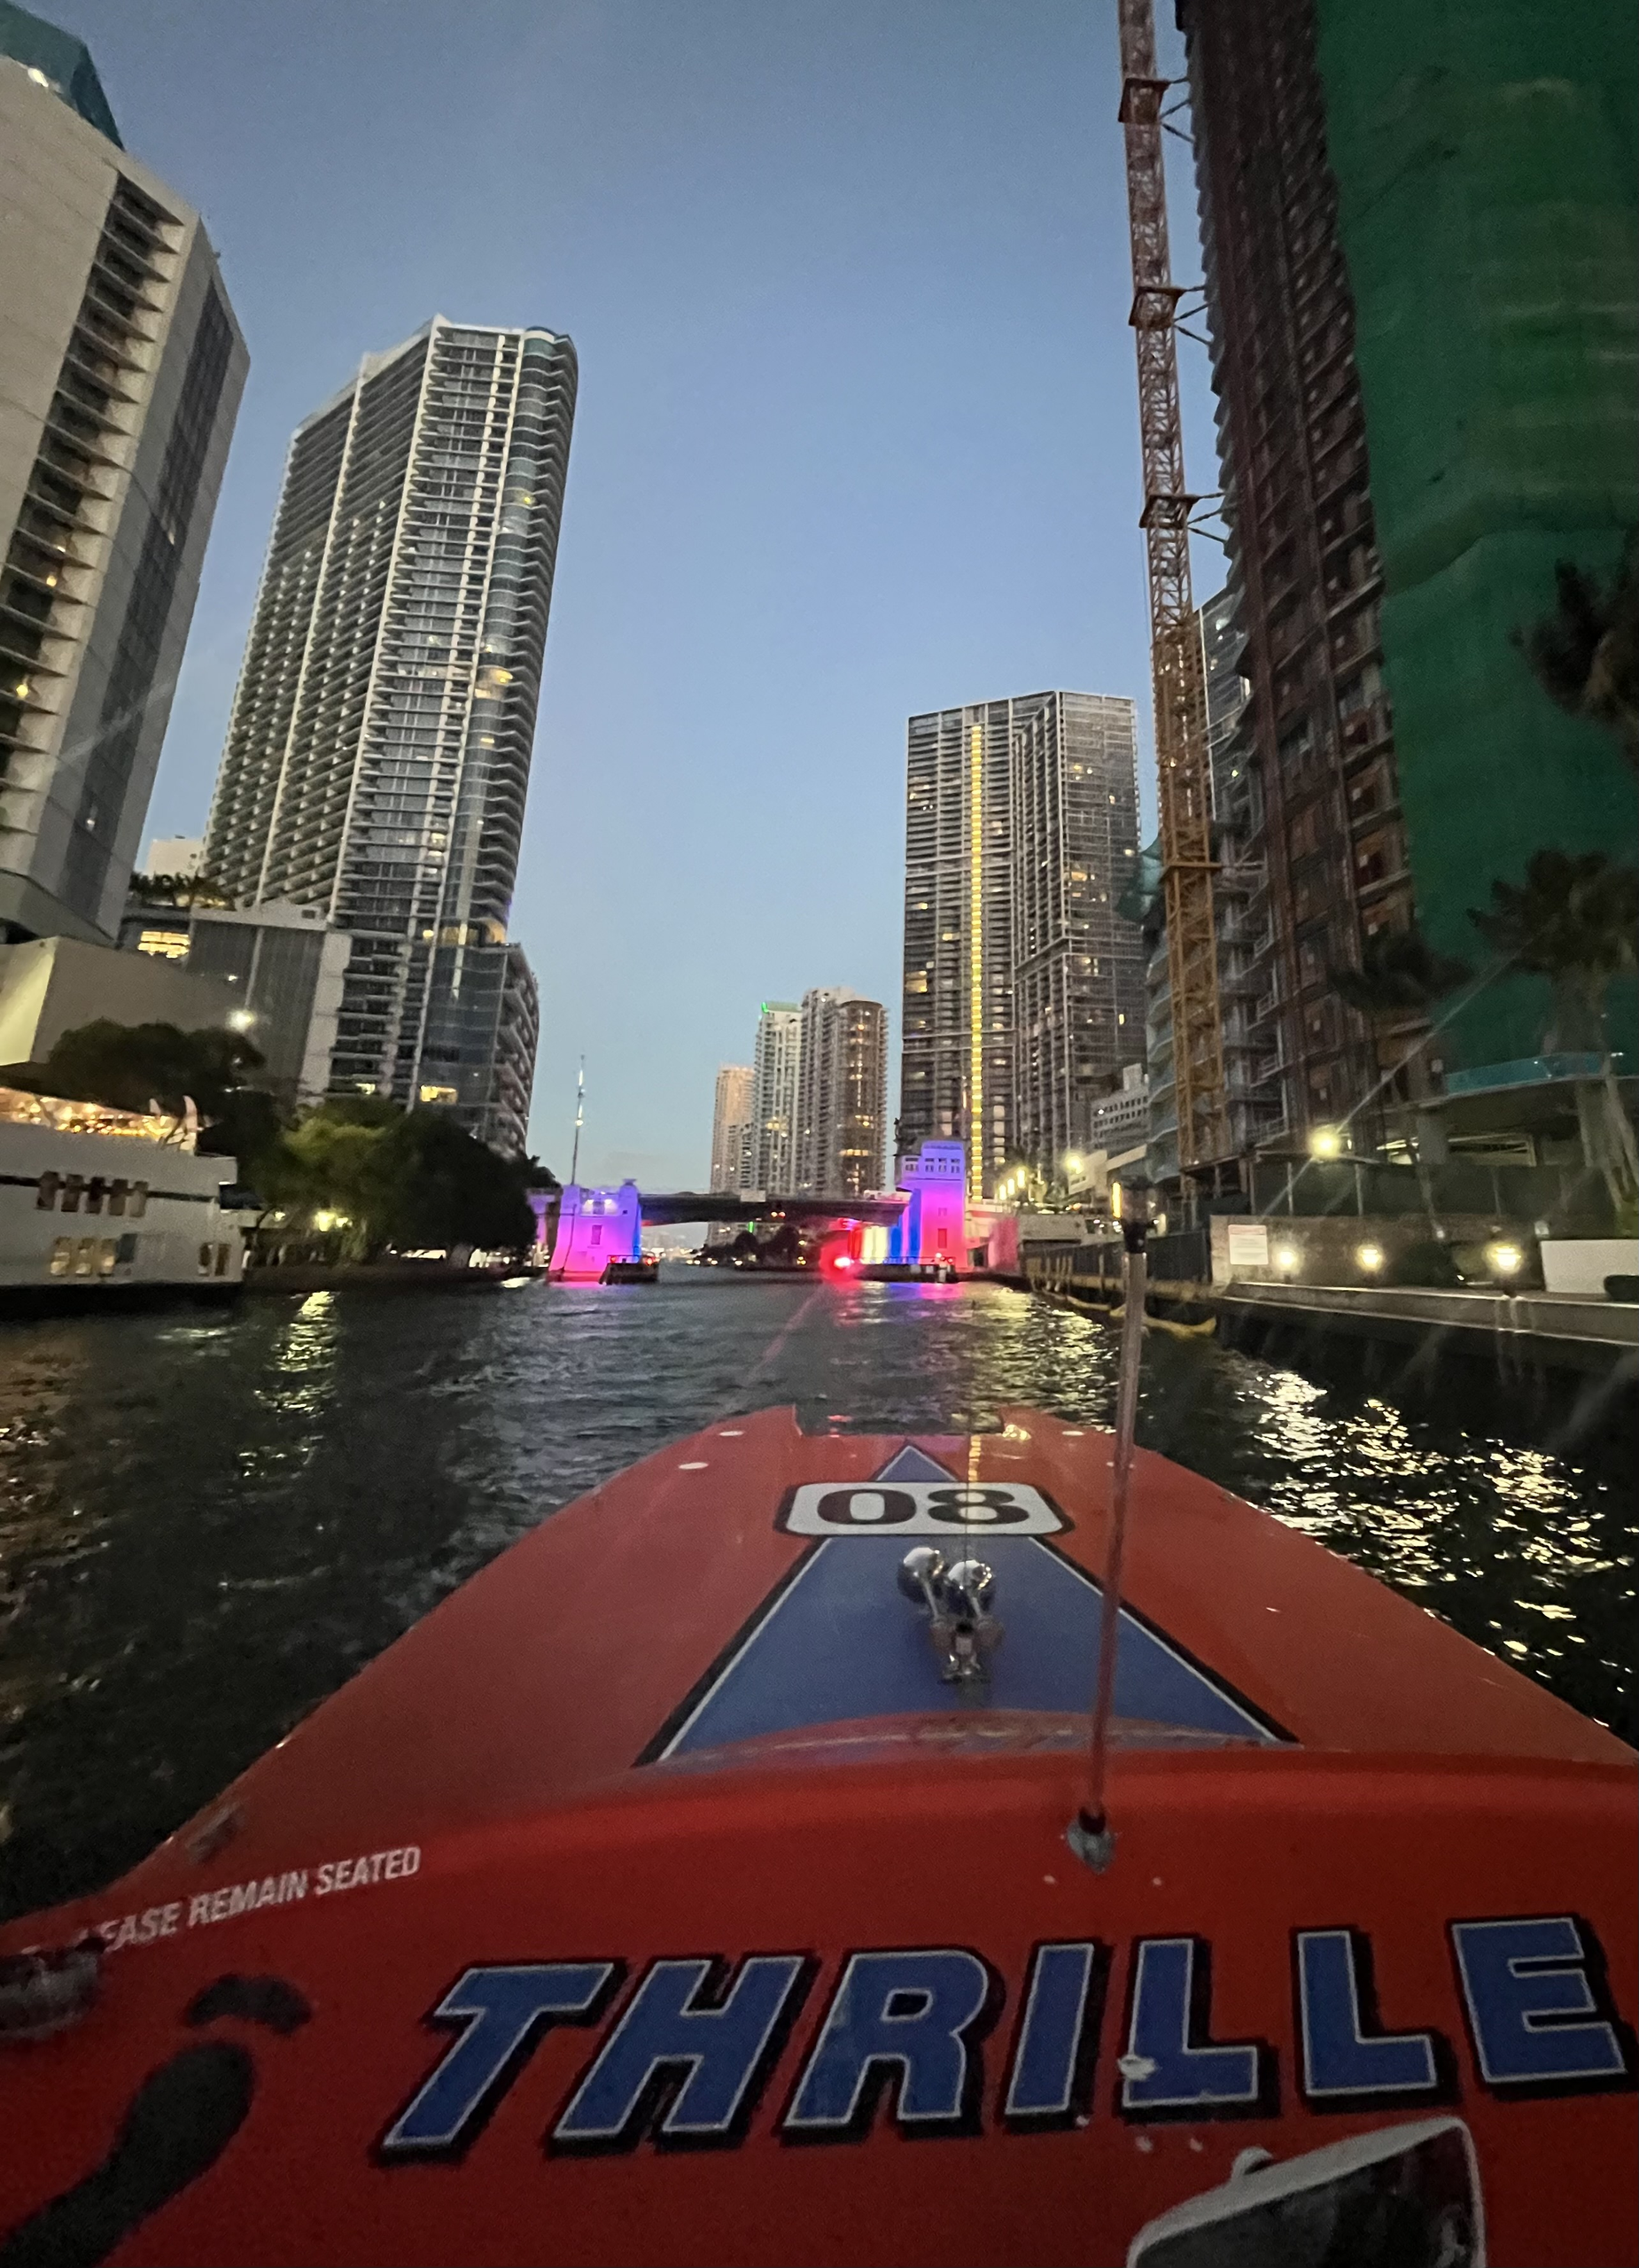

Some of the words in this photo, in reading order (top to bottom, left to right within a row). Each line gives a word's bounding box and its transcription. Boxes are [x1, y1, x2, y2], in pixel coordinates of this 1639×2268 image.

[817, 1488, 1029, 1525] 08
[74, 1901, 183, 1954] EASE
[188, 1868, 308, 1929] REMAIN
[315, 1846, 422, 1896] SEATED
[376, 1912, 1633, 2162] THRILLE
